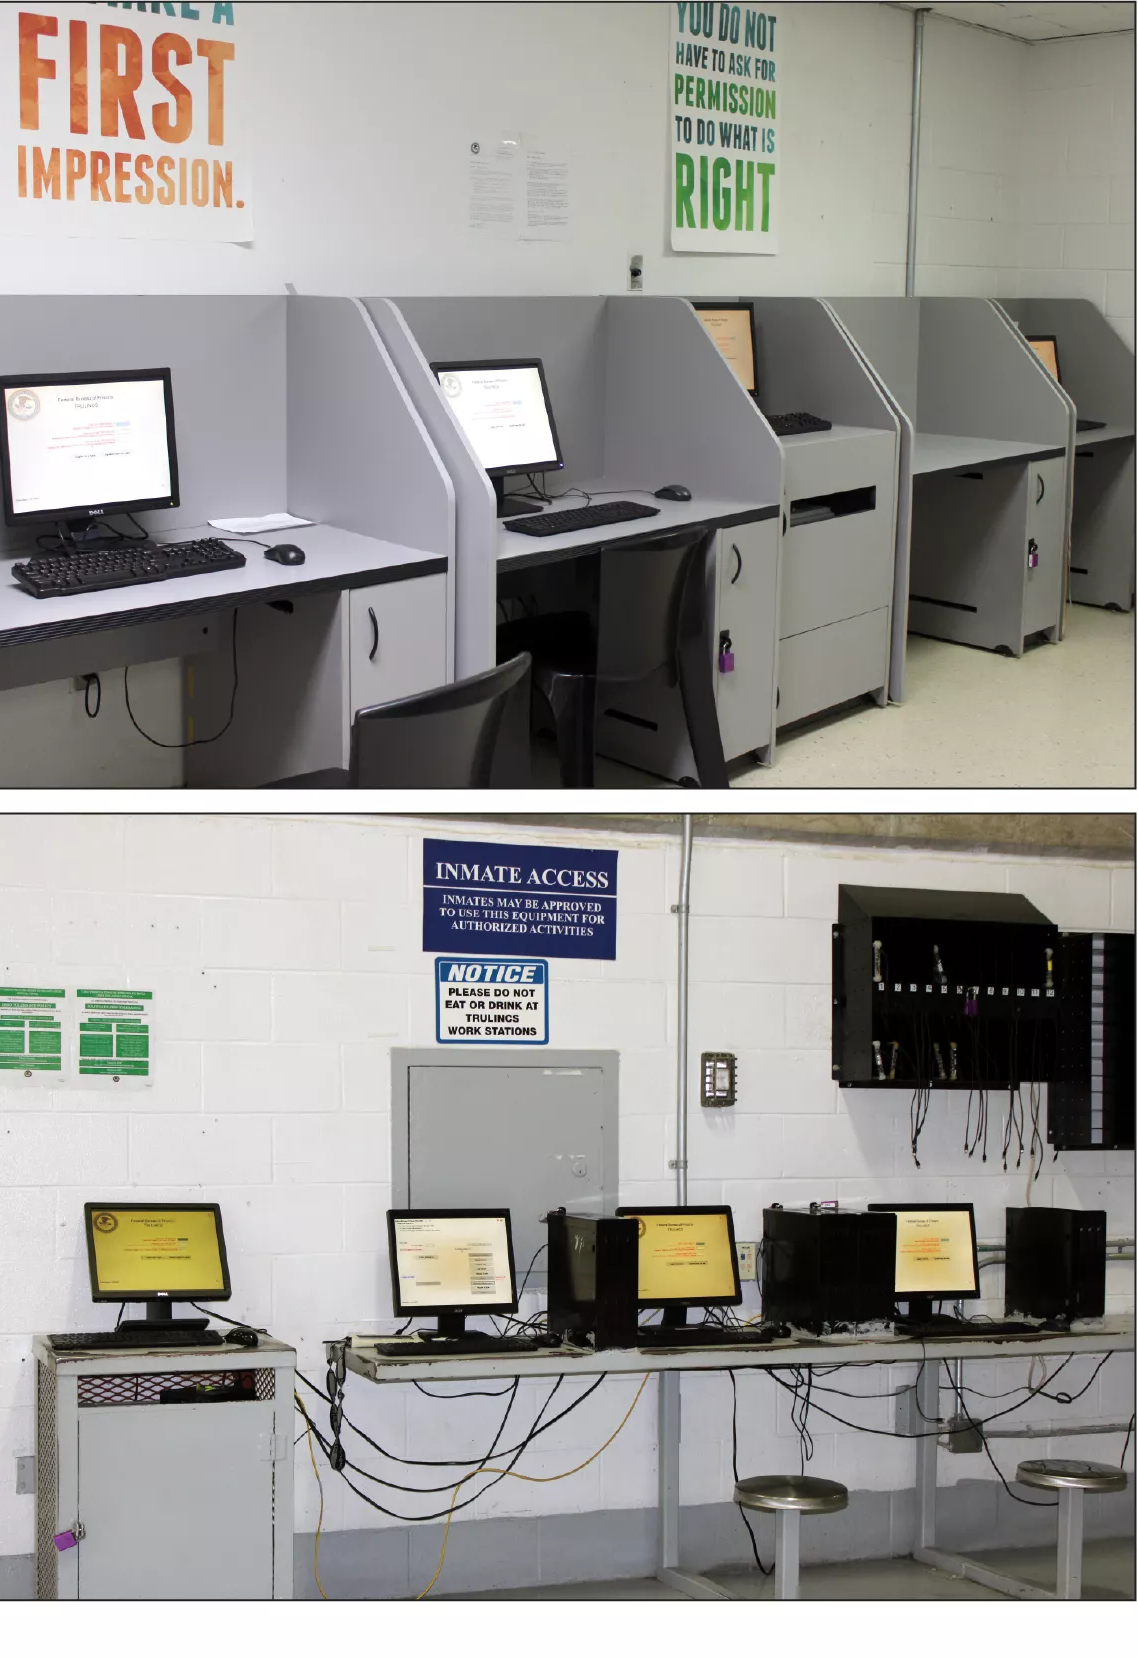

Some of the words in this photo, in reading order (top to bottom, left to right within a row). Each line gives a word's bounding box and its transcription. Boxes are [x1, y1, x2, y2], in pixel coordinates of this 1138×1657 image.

[677, 2, 714, 38] YOU
[719, 3, 741, 44] DO
[745, 9, 777, 52] NOT
[676, 41, 708, 70] HAVE
[712, 48, 725, 72] TO
[729, 52, 752, 78] ASK
[755, 58, 776, 82] FOR
[17, 11, 236, 147] FIRST
[675, 73, 776, 119] PERMISSION
[675, 115, 692, 144] TO
[697, 118, 715, 146] DO
[719, 121, 758, 151] WHAT
[762, 128, 775, 153] IS
[17, 144, 245, 209] IMPRESSION.
[676, 152, 776, 232] RIGHT
[435, 862, 522, 884] INMATE
[526, 868, 609, 889] ACCESS
[443, 894, 494, 907] INMATES
[497, 897, 522, 908] MAY
[525, 899, 539, 910] BE
[541, 900, 602, 913] APPROVED
[439, 907, 455, 917] TO
[458, 908, 480, 918] USE
[482, 909, 509, 920] THIS
[512, 911, 580, 923] EQUIPMENT
[582, 914, 605, 925] FOR
[451, 920, 527, 934] AUTHORIZED
[529, 924, 594, 936] ACTIVITIES
[447, 964, 537, 983] NOTICE
[448, 988, 490, 997] PLEASE
[494, 989, 510, 997] DO
[513, 989, 535, 997] NOT
[445, 1000, 466, 1009] EAT
[469, 1001, 485, 1009] OR
[489, 1001, 522, 1010] DRINK
[526, 1002, 538, 1010] AT
[466, 1014, 519, 1023] TRULINCS
[448, 1026, 481, 1035] WORK
[485, 1027, 537, 1036] STATIONS
